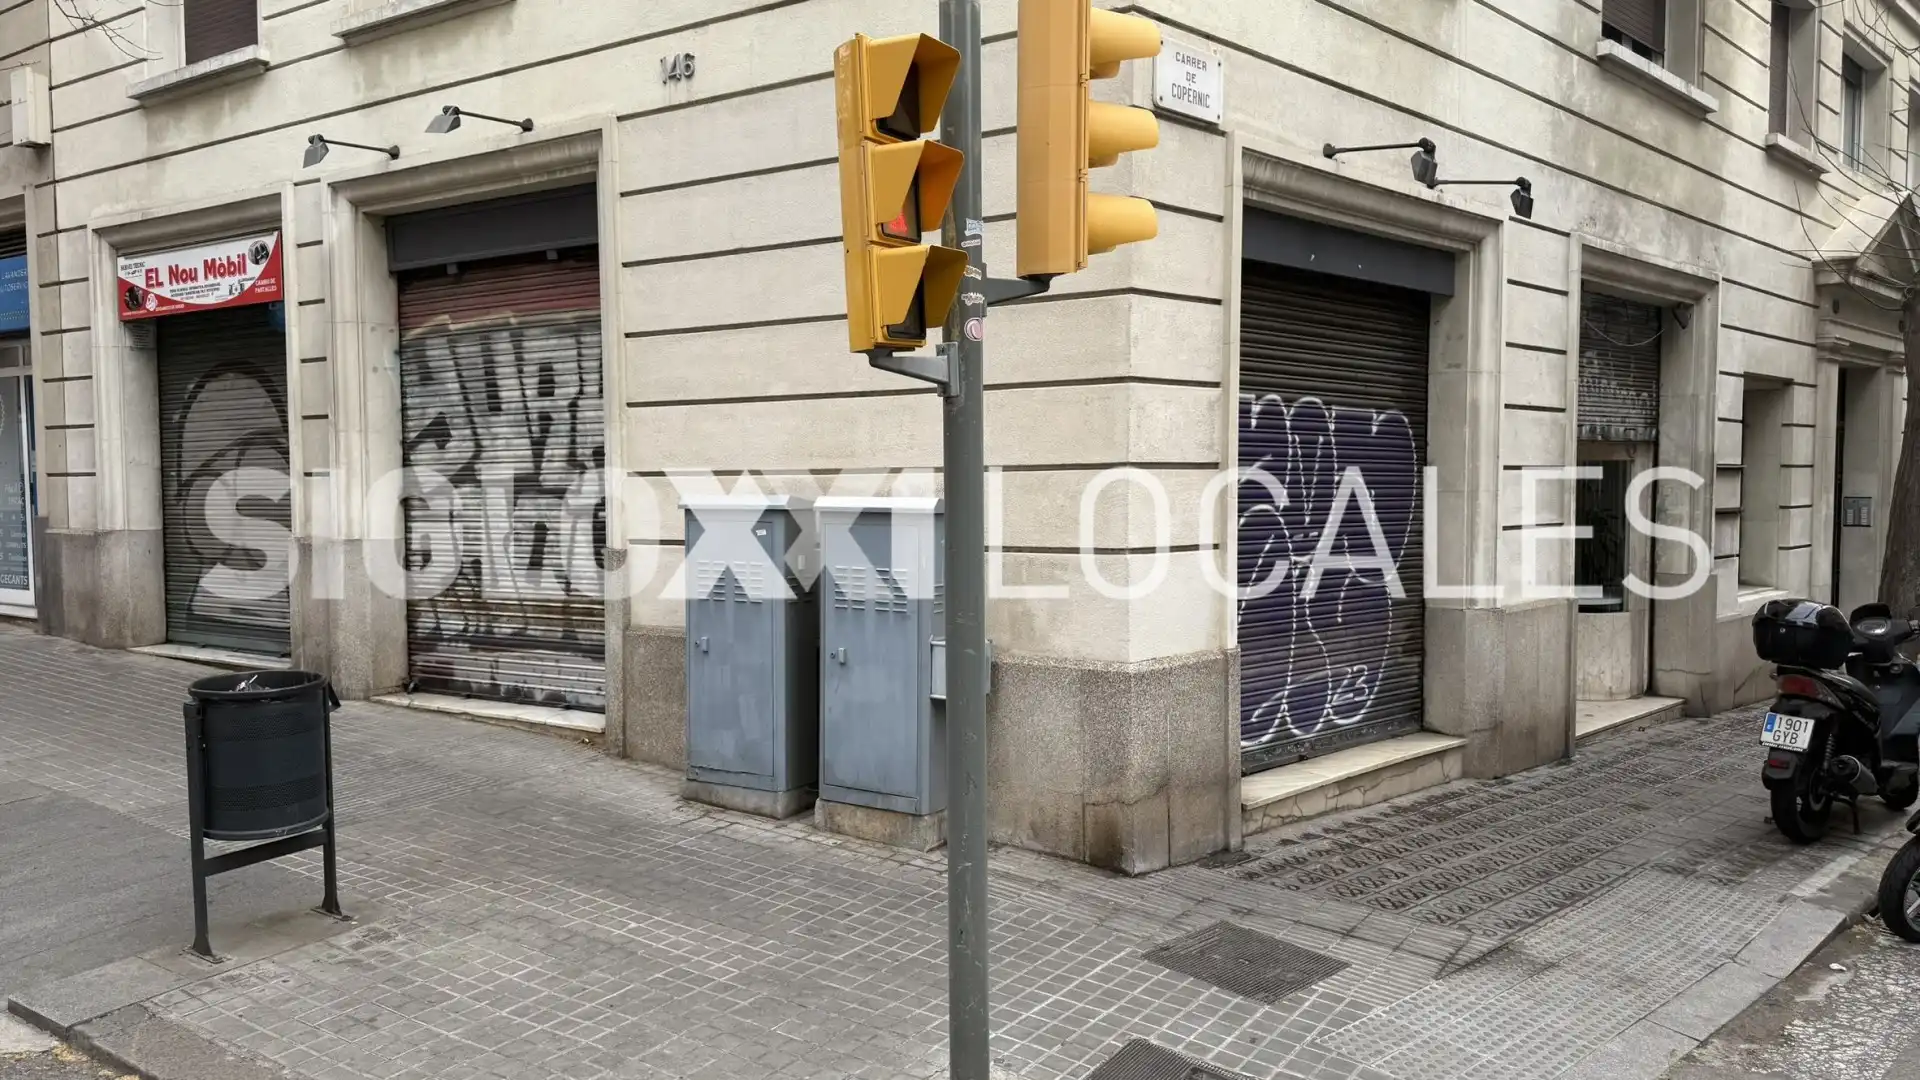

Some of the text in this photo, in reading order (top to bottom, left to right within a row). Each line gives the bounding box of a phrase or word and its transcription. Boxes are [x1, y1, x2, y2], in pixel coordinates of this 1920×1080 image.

[659, 53, 696, 84] 146
[1175, 51, 1207, 72] CARRER
[1185, 71, 1197, 84] DE
[144, 266, 165, 289] EL
[168, 263, 199, 287] Nou
[203, 252, 248, 282] Mòbil
[1777, 717, 1808, 733] 1901
[1772, 729, 1799, 745] GYB
